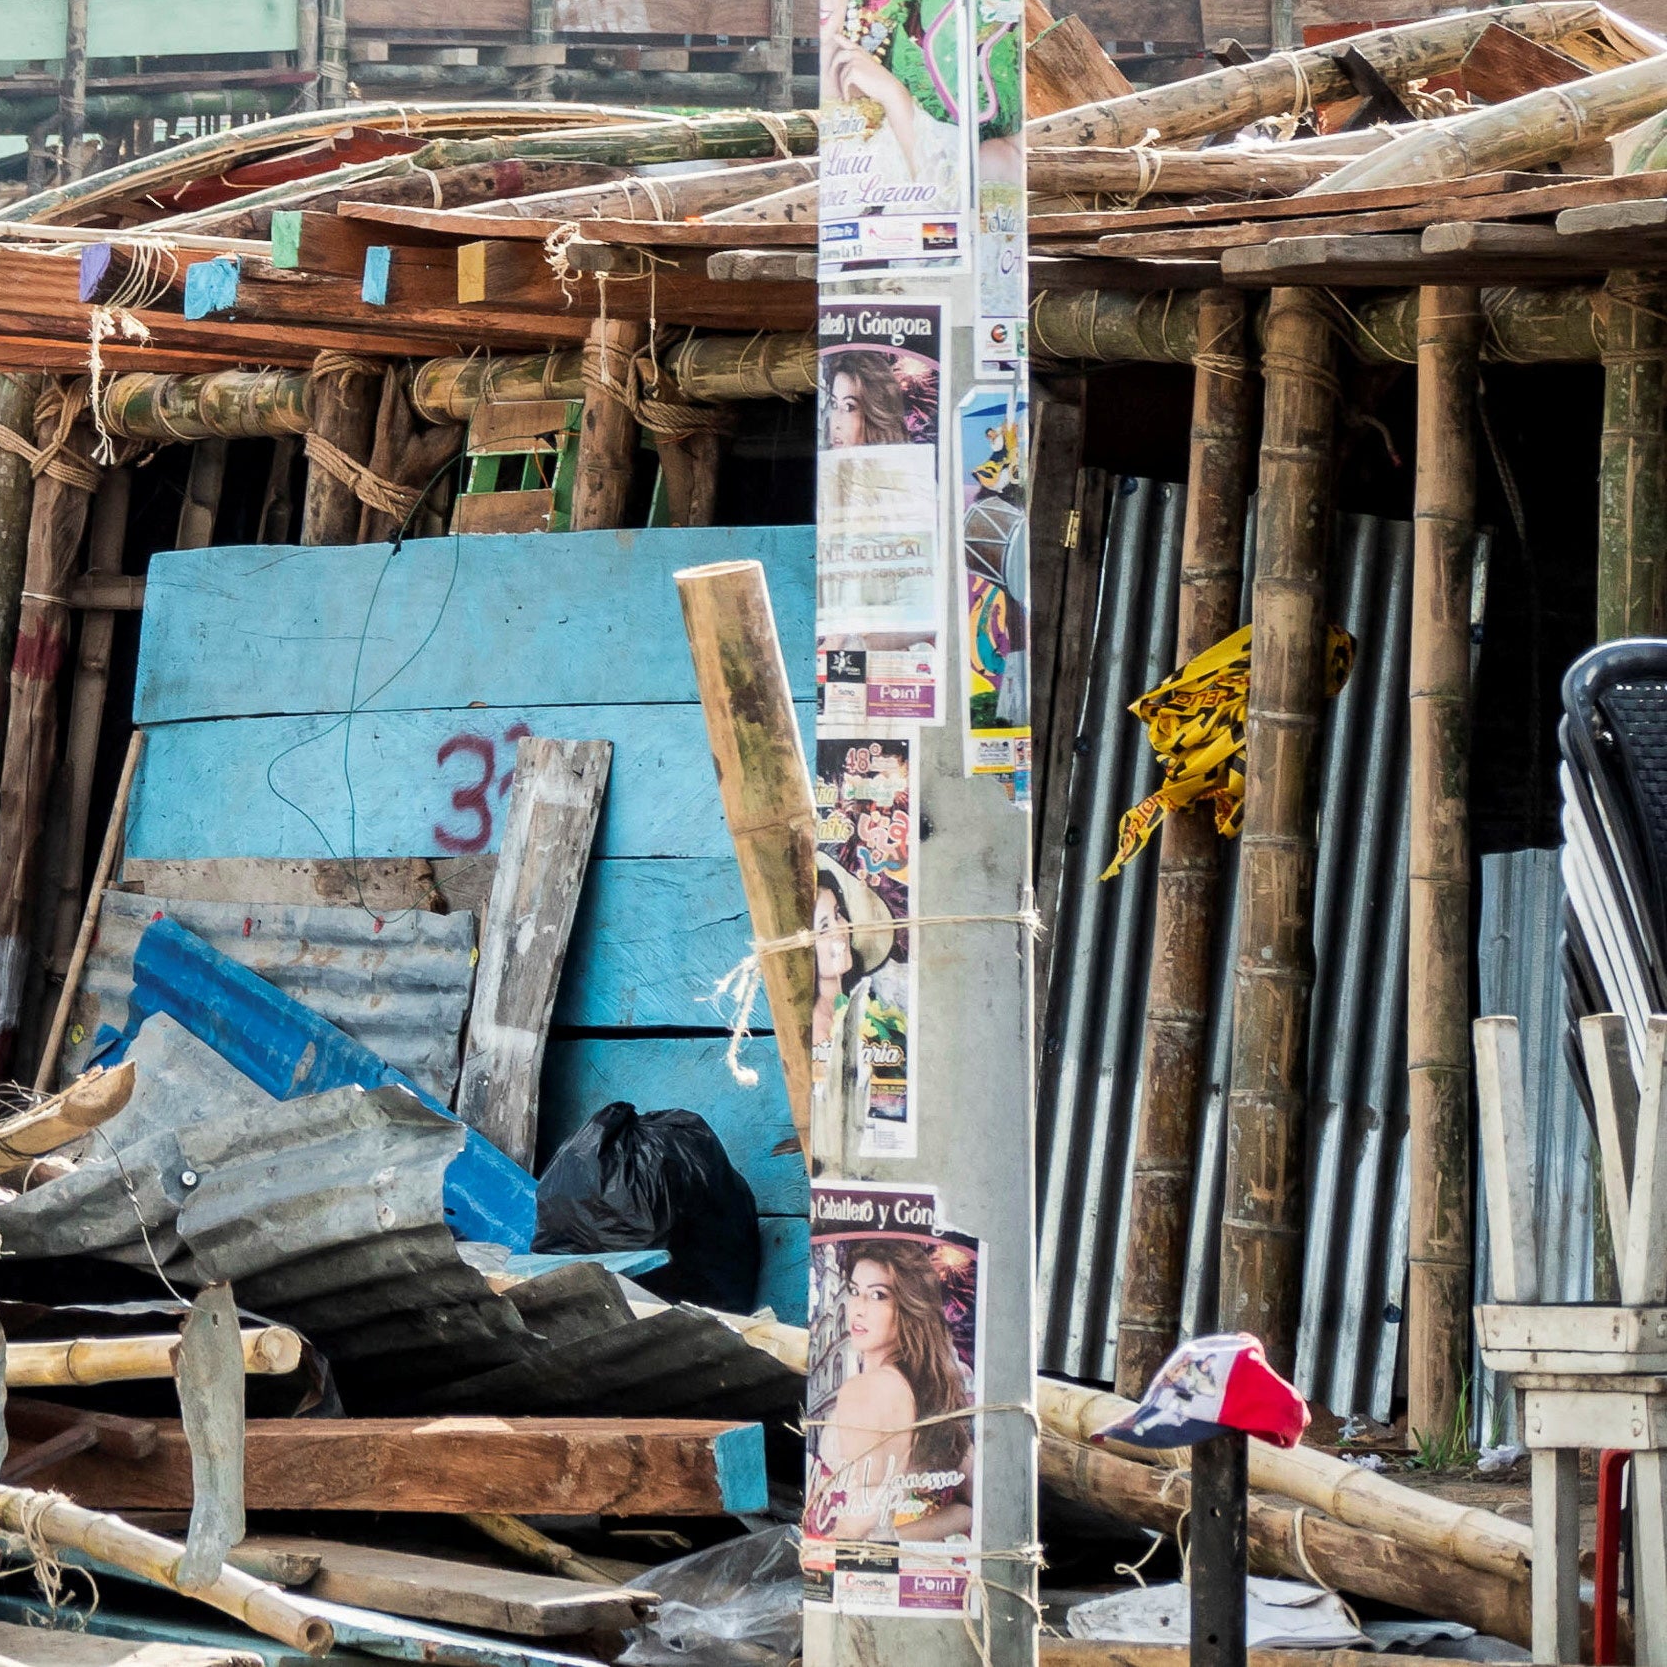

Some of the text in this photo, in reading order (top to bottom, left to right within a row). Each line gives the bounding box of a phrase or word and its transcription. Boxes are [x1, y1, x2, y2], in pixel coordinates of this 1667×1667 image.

[854, 175, 936, 204] Lozano
[858, 310, 933, 346] Góngora
[434, 722, 532, 853] 3
[818, 1194, 874, 1222] Caballero
[913, 1575, 956, 1592] Point
